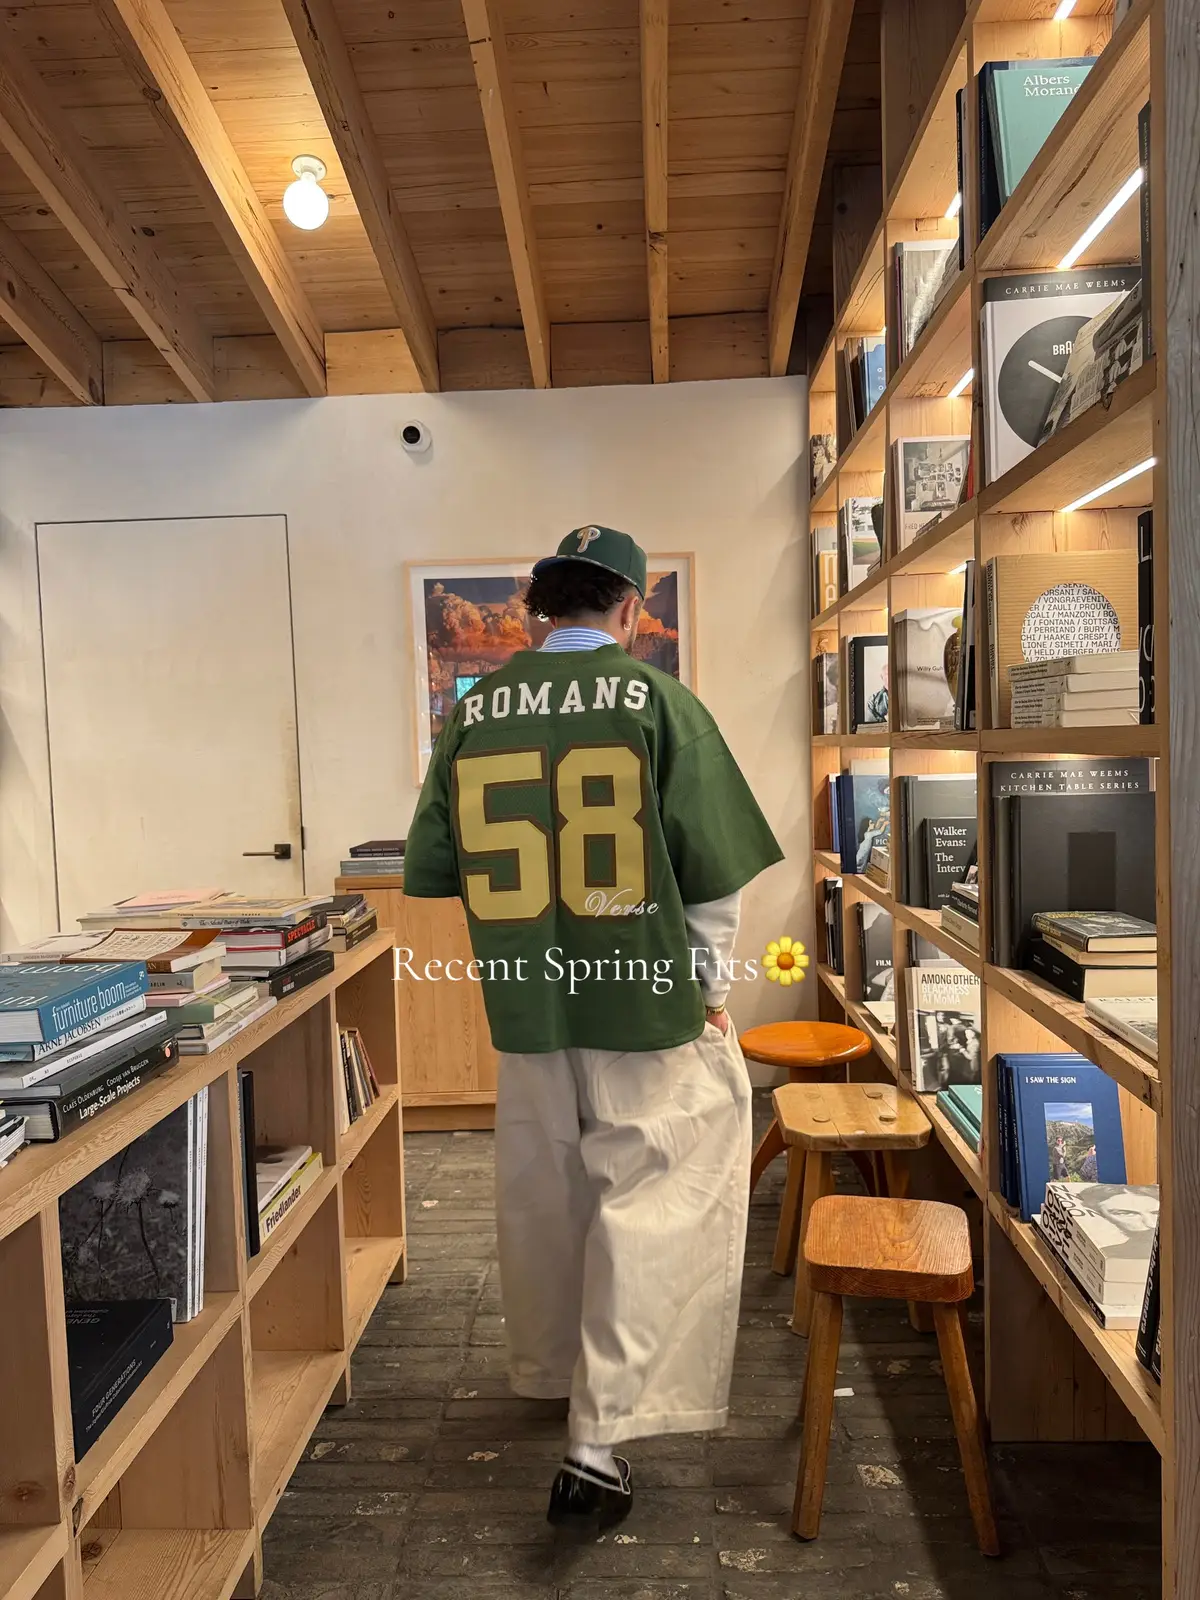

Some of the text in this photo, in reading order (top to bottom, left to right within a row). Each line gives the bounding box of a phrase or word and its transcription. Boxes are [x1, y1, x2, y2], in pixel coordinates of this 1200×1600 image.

[1023, 75, 1070, 86] Albers
[1005, 279, 1126, 295] CARRIE MAE WEEMS
[1053, 341, 1075, 355] BRA
[577, 526, 601, 553] P
[463, 676, 649, 727] ROMANS
[1000, 784, 1052, 792] KITCHEN
[452, 741, 651, 925] 58
[933, 826, 967, 836] Walker
[935, 838, 966, 847] Evans:
[935, 852, 954, 862] The
[937, 864, 966, 873] Interv
[585, 888, 659, 918] Verse
[287, 919, 316, 943] SPECTACLE
[921, 974, 980, 985] AMONG OTHER
[52, 995, 98, 1032] furniture
[97, 982, 126, 1010] boom
[38, 1017, 101, 1055] ARNE JACOBSEN
[62, 1100, 78, 1113] CLAES
[77, 1085, 105, 1104] OLDENBURG
[130, 1059, 149, 1072] BRUGGEN
[1060, 1076, 1076, 1084] SIGN
[79, 1076, 140, 1119] Large-Scale Projects
[265, 1184, 301, 1233] Friedlander
[1140, 1276, 1153, 1334] Camera
[92, 1396, 105, 1417] FOUR
[105, 1358, 137, 1400] GENERATIONS
